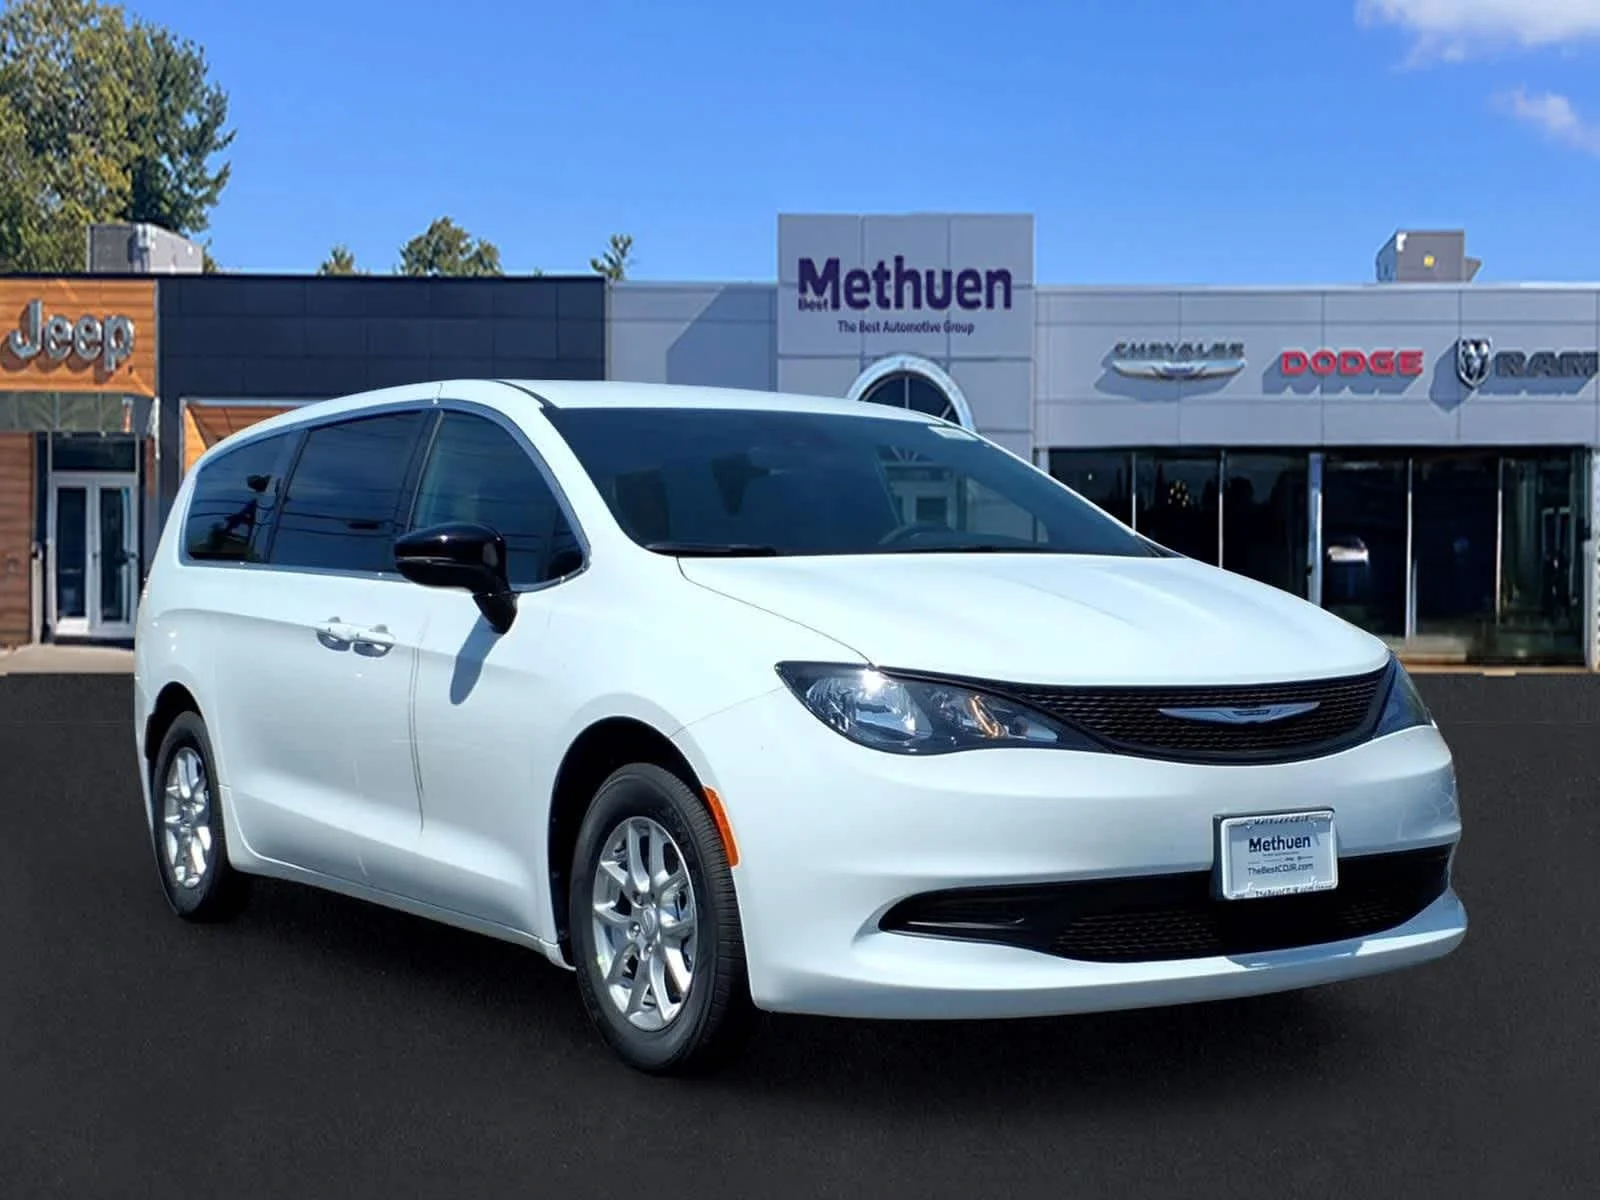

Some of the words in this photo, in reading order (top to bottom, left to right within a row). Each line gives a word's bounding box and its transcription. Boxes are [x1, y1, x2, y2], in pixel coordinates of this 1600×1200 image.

[798, 255, 1012, 311] Methuen
[9, 299, 135, 372] Jeep
[838, 320, 857, 333] The
[859, 320, 880, 333] Best
[883, 320, 941, 333] Automotive
[943, 320, 975, 336] Group
[1281, 351, 1424, 376] DODGE
[1495, 351, 1599, 377] RAM
[1248, 836, 1311, 853] Methuen
